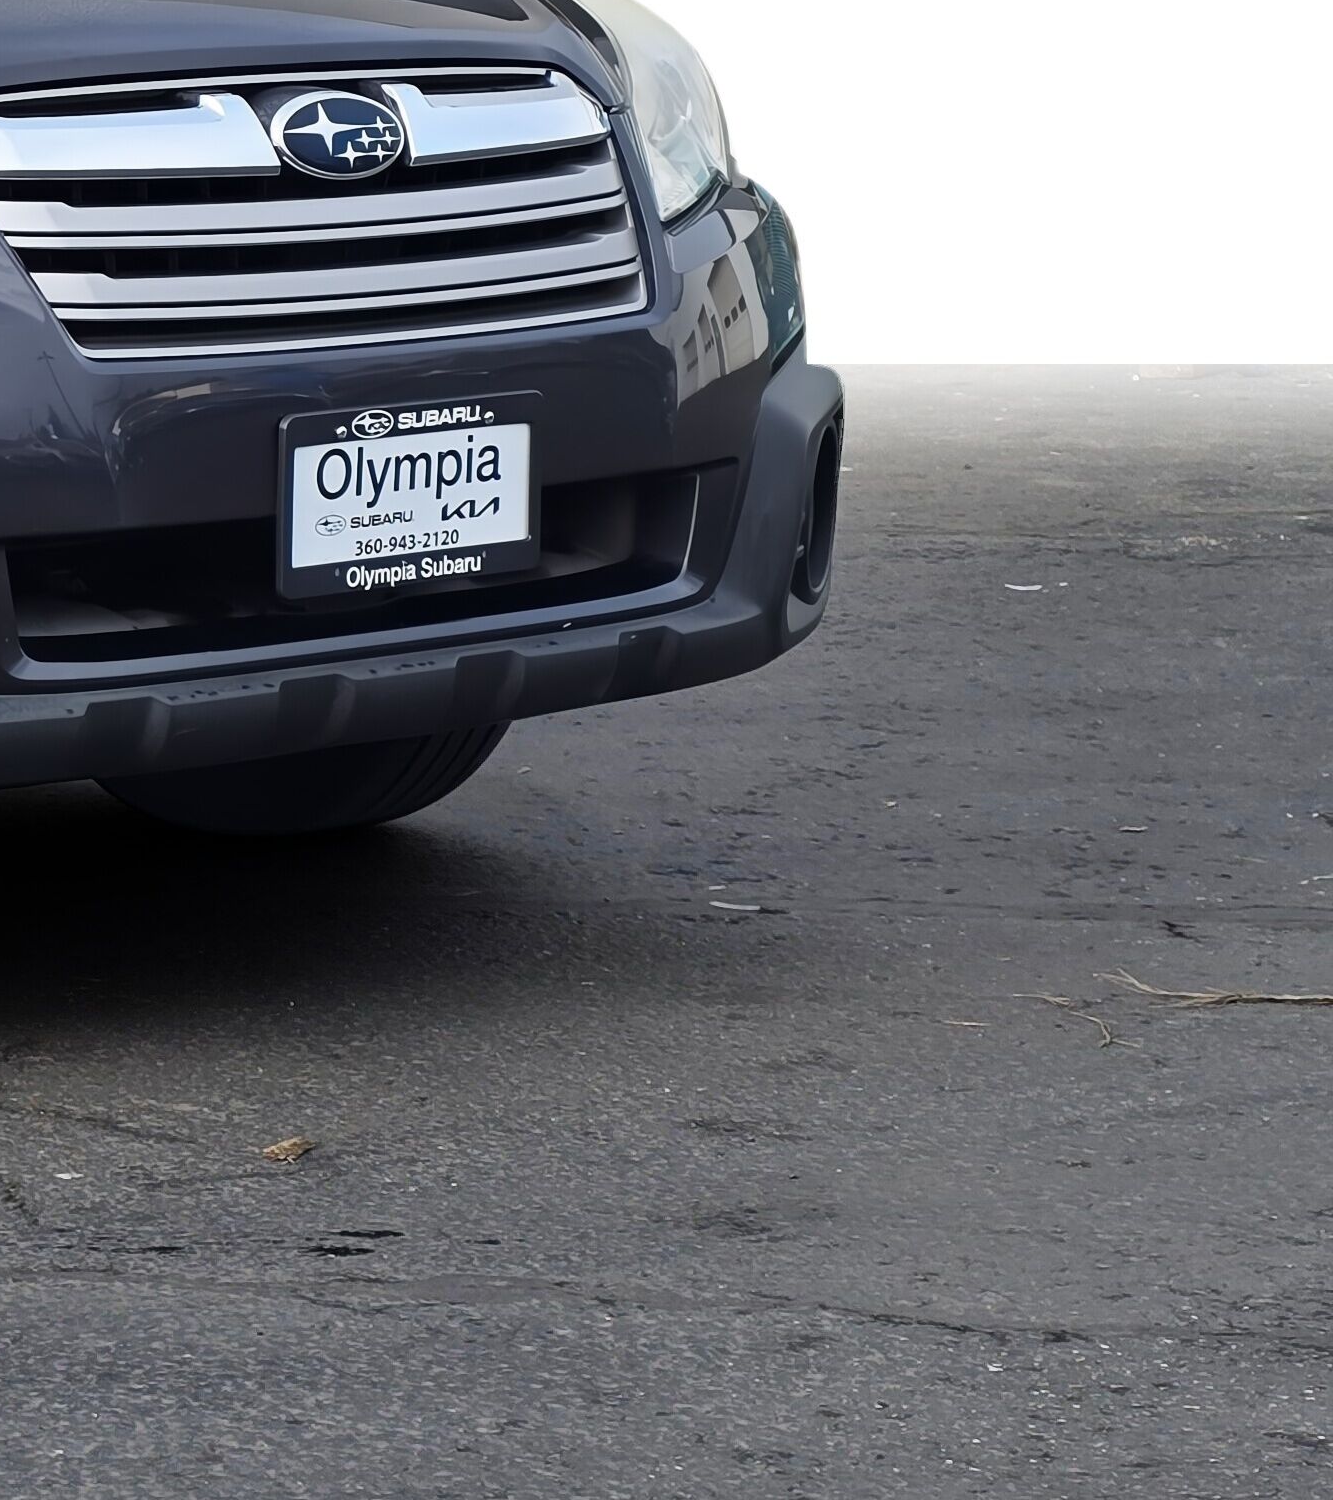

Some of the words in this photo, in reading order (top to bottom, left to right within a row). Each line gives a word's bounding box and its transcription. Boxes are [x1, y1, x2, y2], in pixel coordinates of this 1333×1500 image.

[316, 434, 501, 508] Olympia
[355, 529, 460, 556] 360-943-2120
[345, 558, 417, 590] Olympia
[420, 554, 482, 579] Subaru
